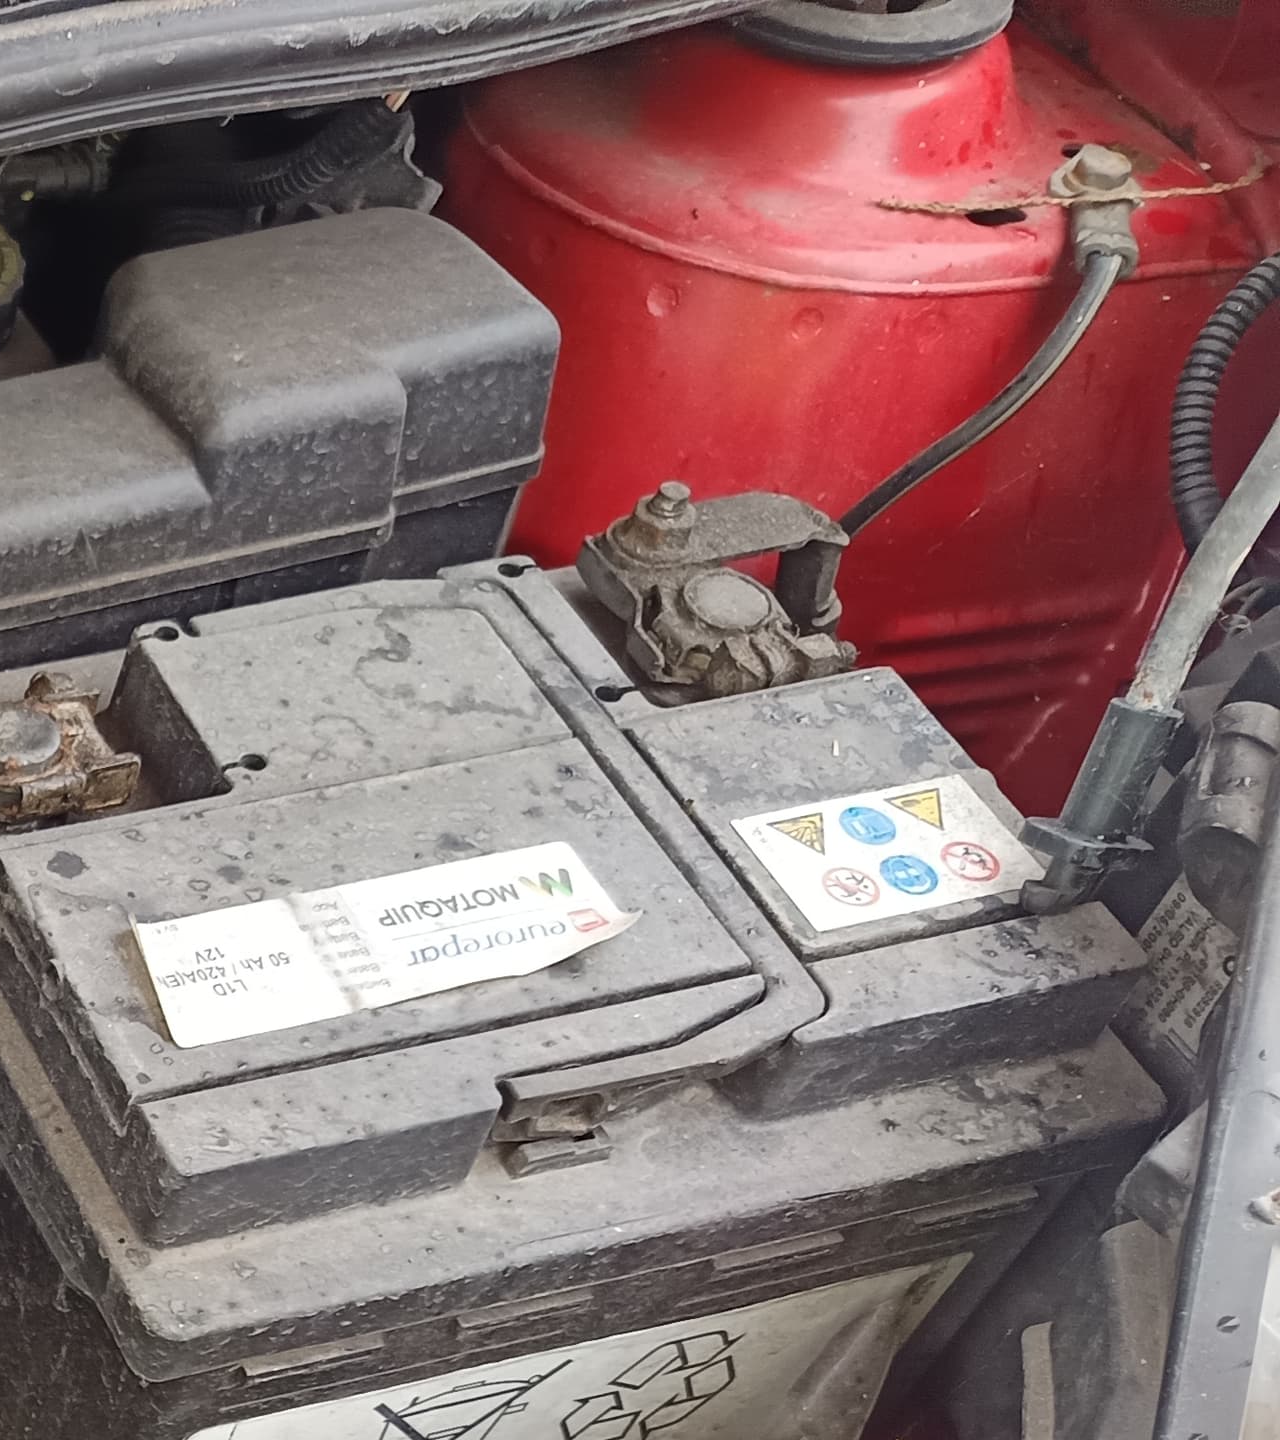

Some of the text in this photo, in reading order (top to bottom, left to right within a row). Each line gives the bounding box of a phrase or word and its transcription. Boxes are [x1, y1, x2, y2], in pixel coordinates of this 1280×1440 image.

[378, 882, 521, 928] MOTAQUIP
[406, 920, 568, 968] eurorepar
[193, 946, 226, 966] 12V
[239, 955, 264, 972] Ah
[268, 951, 291, 968] 50
[212, 978, 249, 997] L1D
